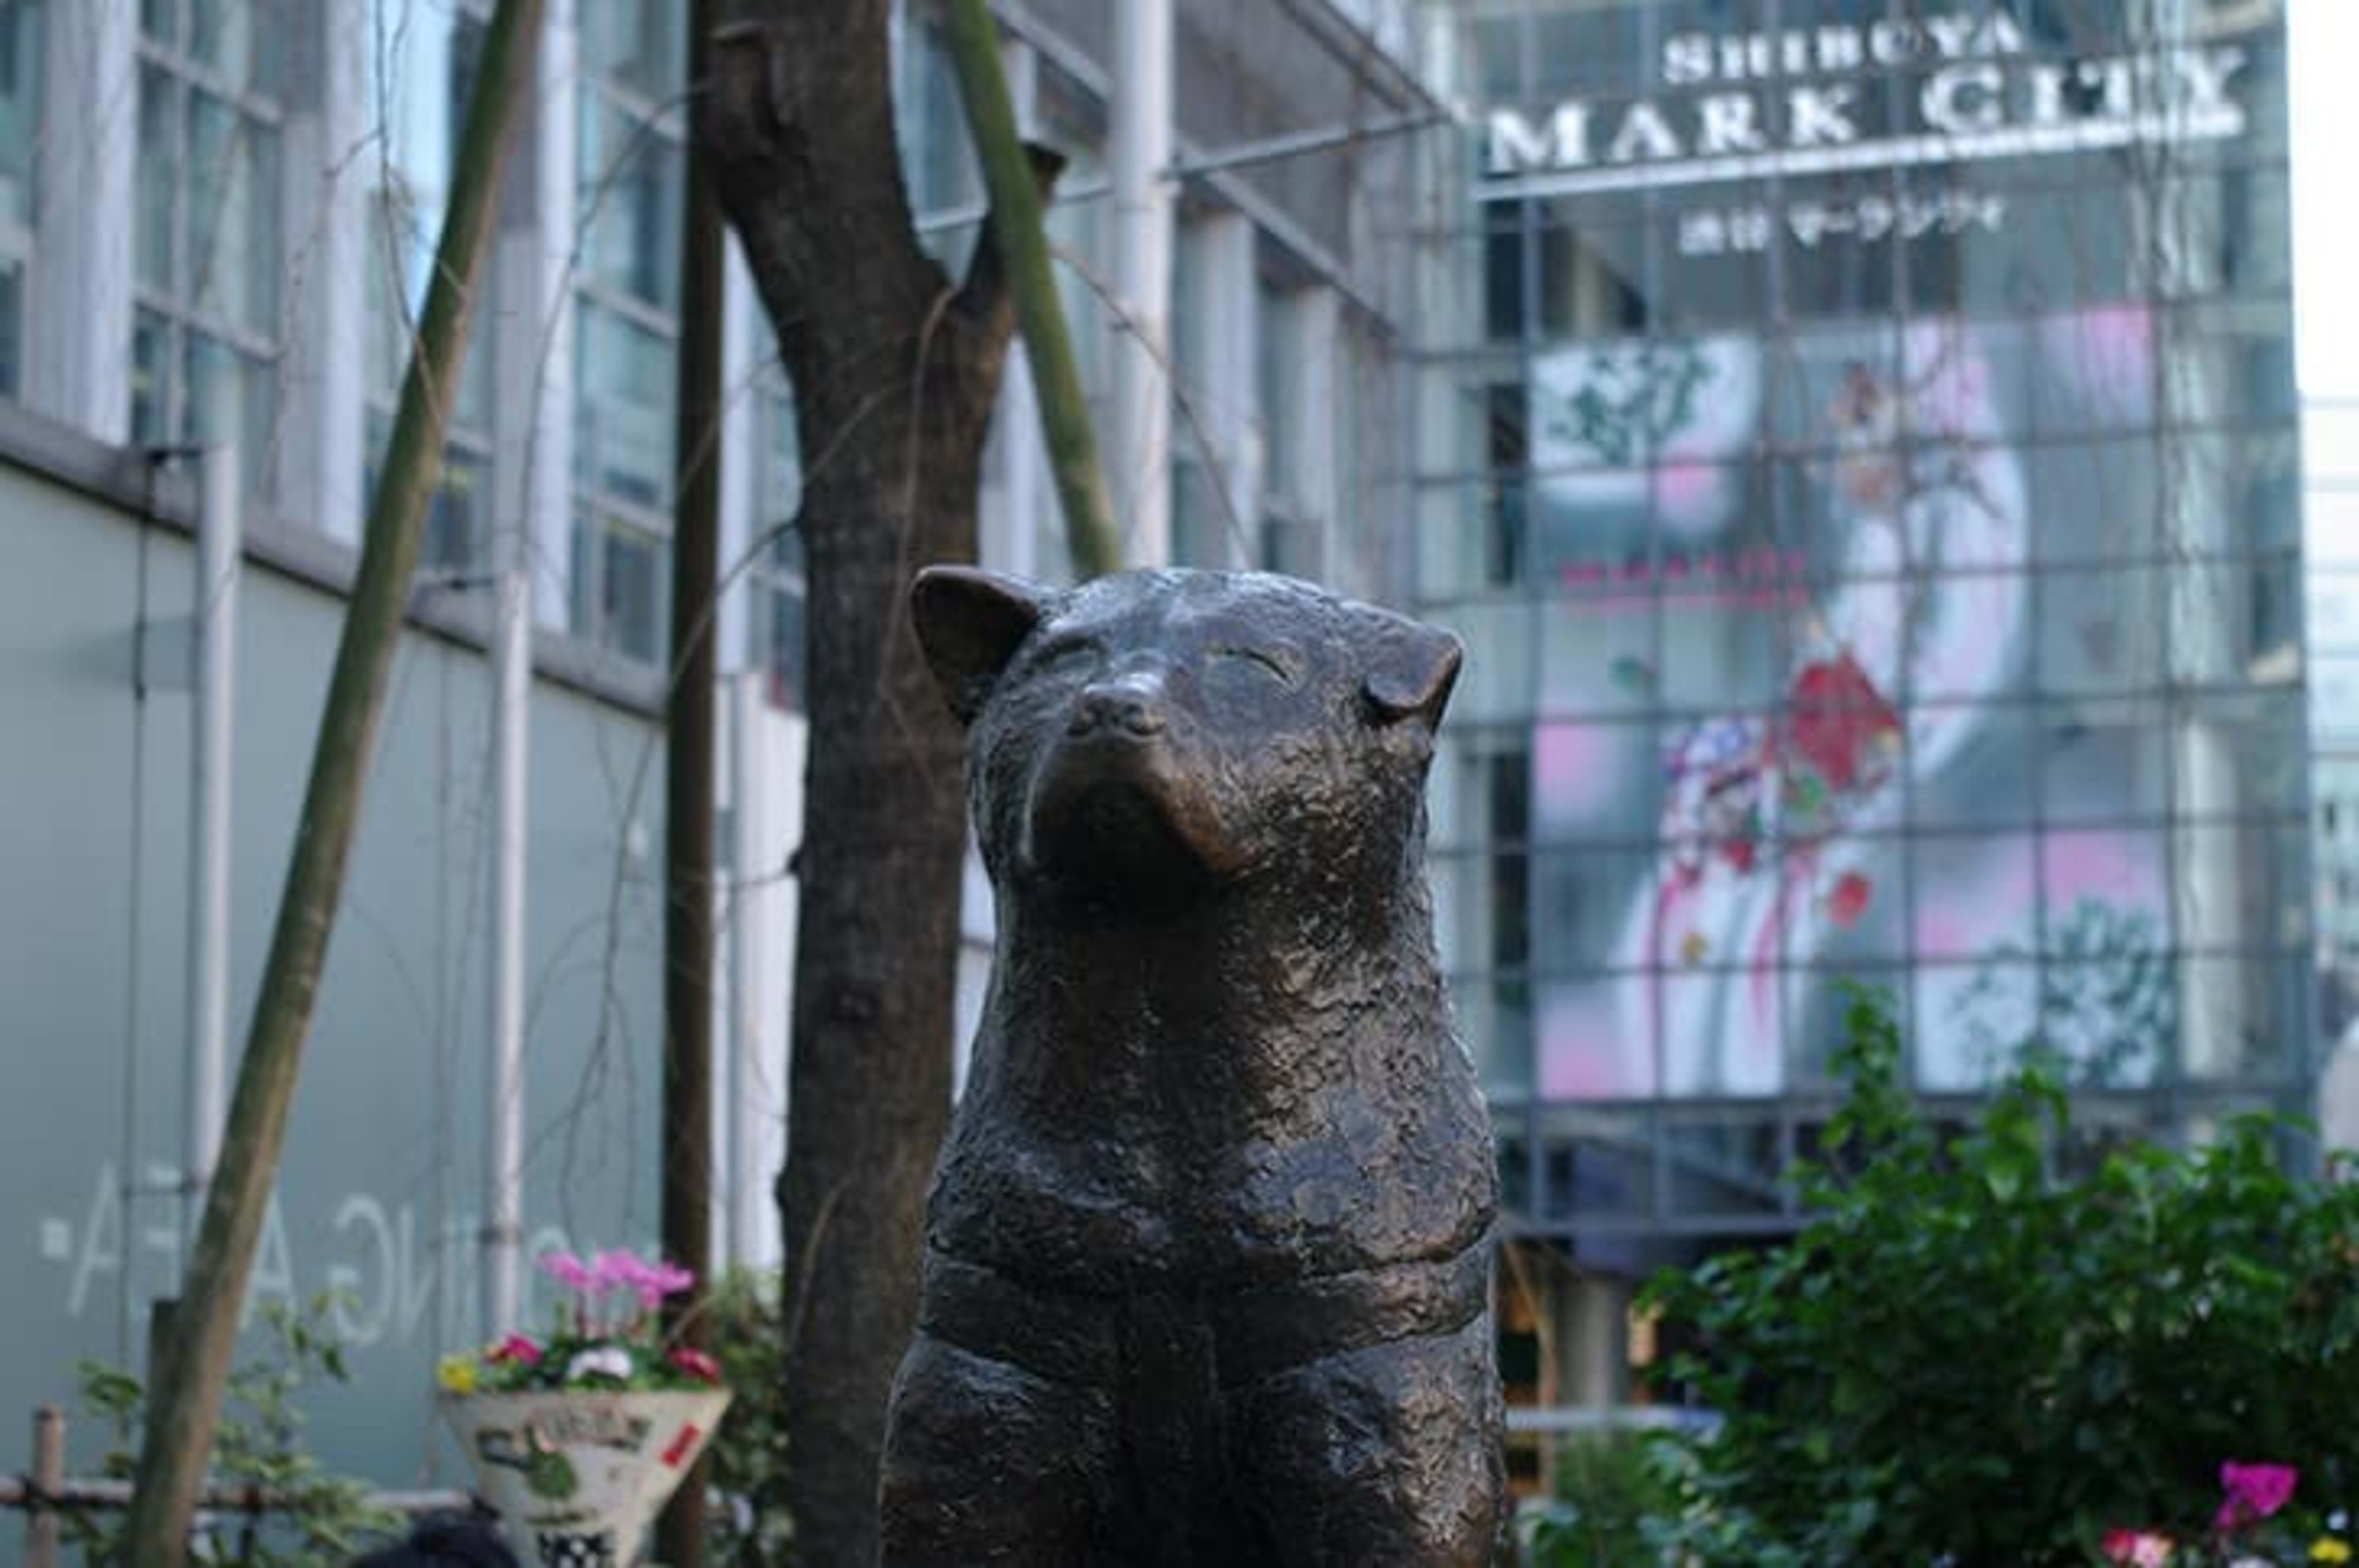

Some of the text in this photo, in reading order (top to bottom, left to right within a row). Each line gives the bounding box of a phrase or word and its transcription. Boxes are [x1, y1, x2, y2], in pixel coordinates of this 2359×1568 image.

[1664, 9, 2021, 84] SHIBUYA
[1488, 50, 2245, 172] MARK CITY
